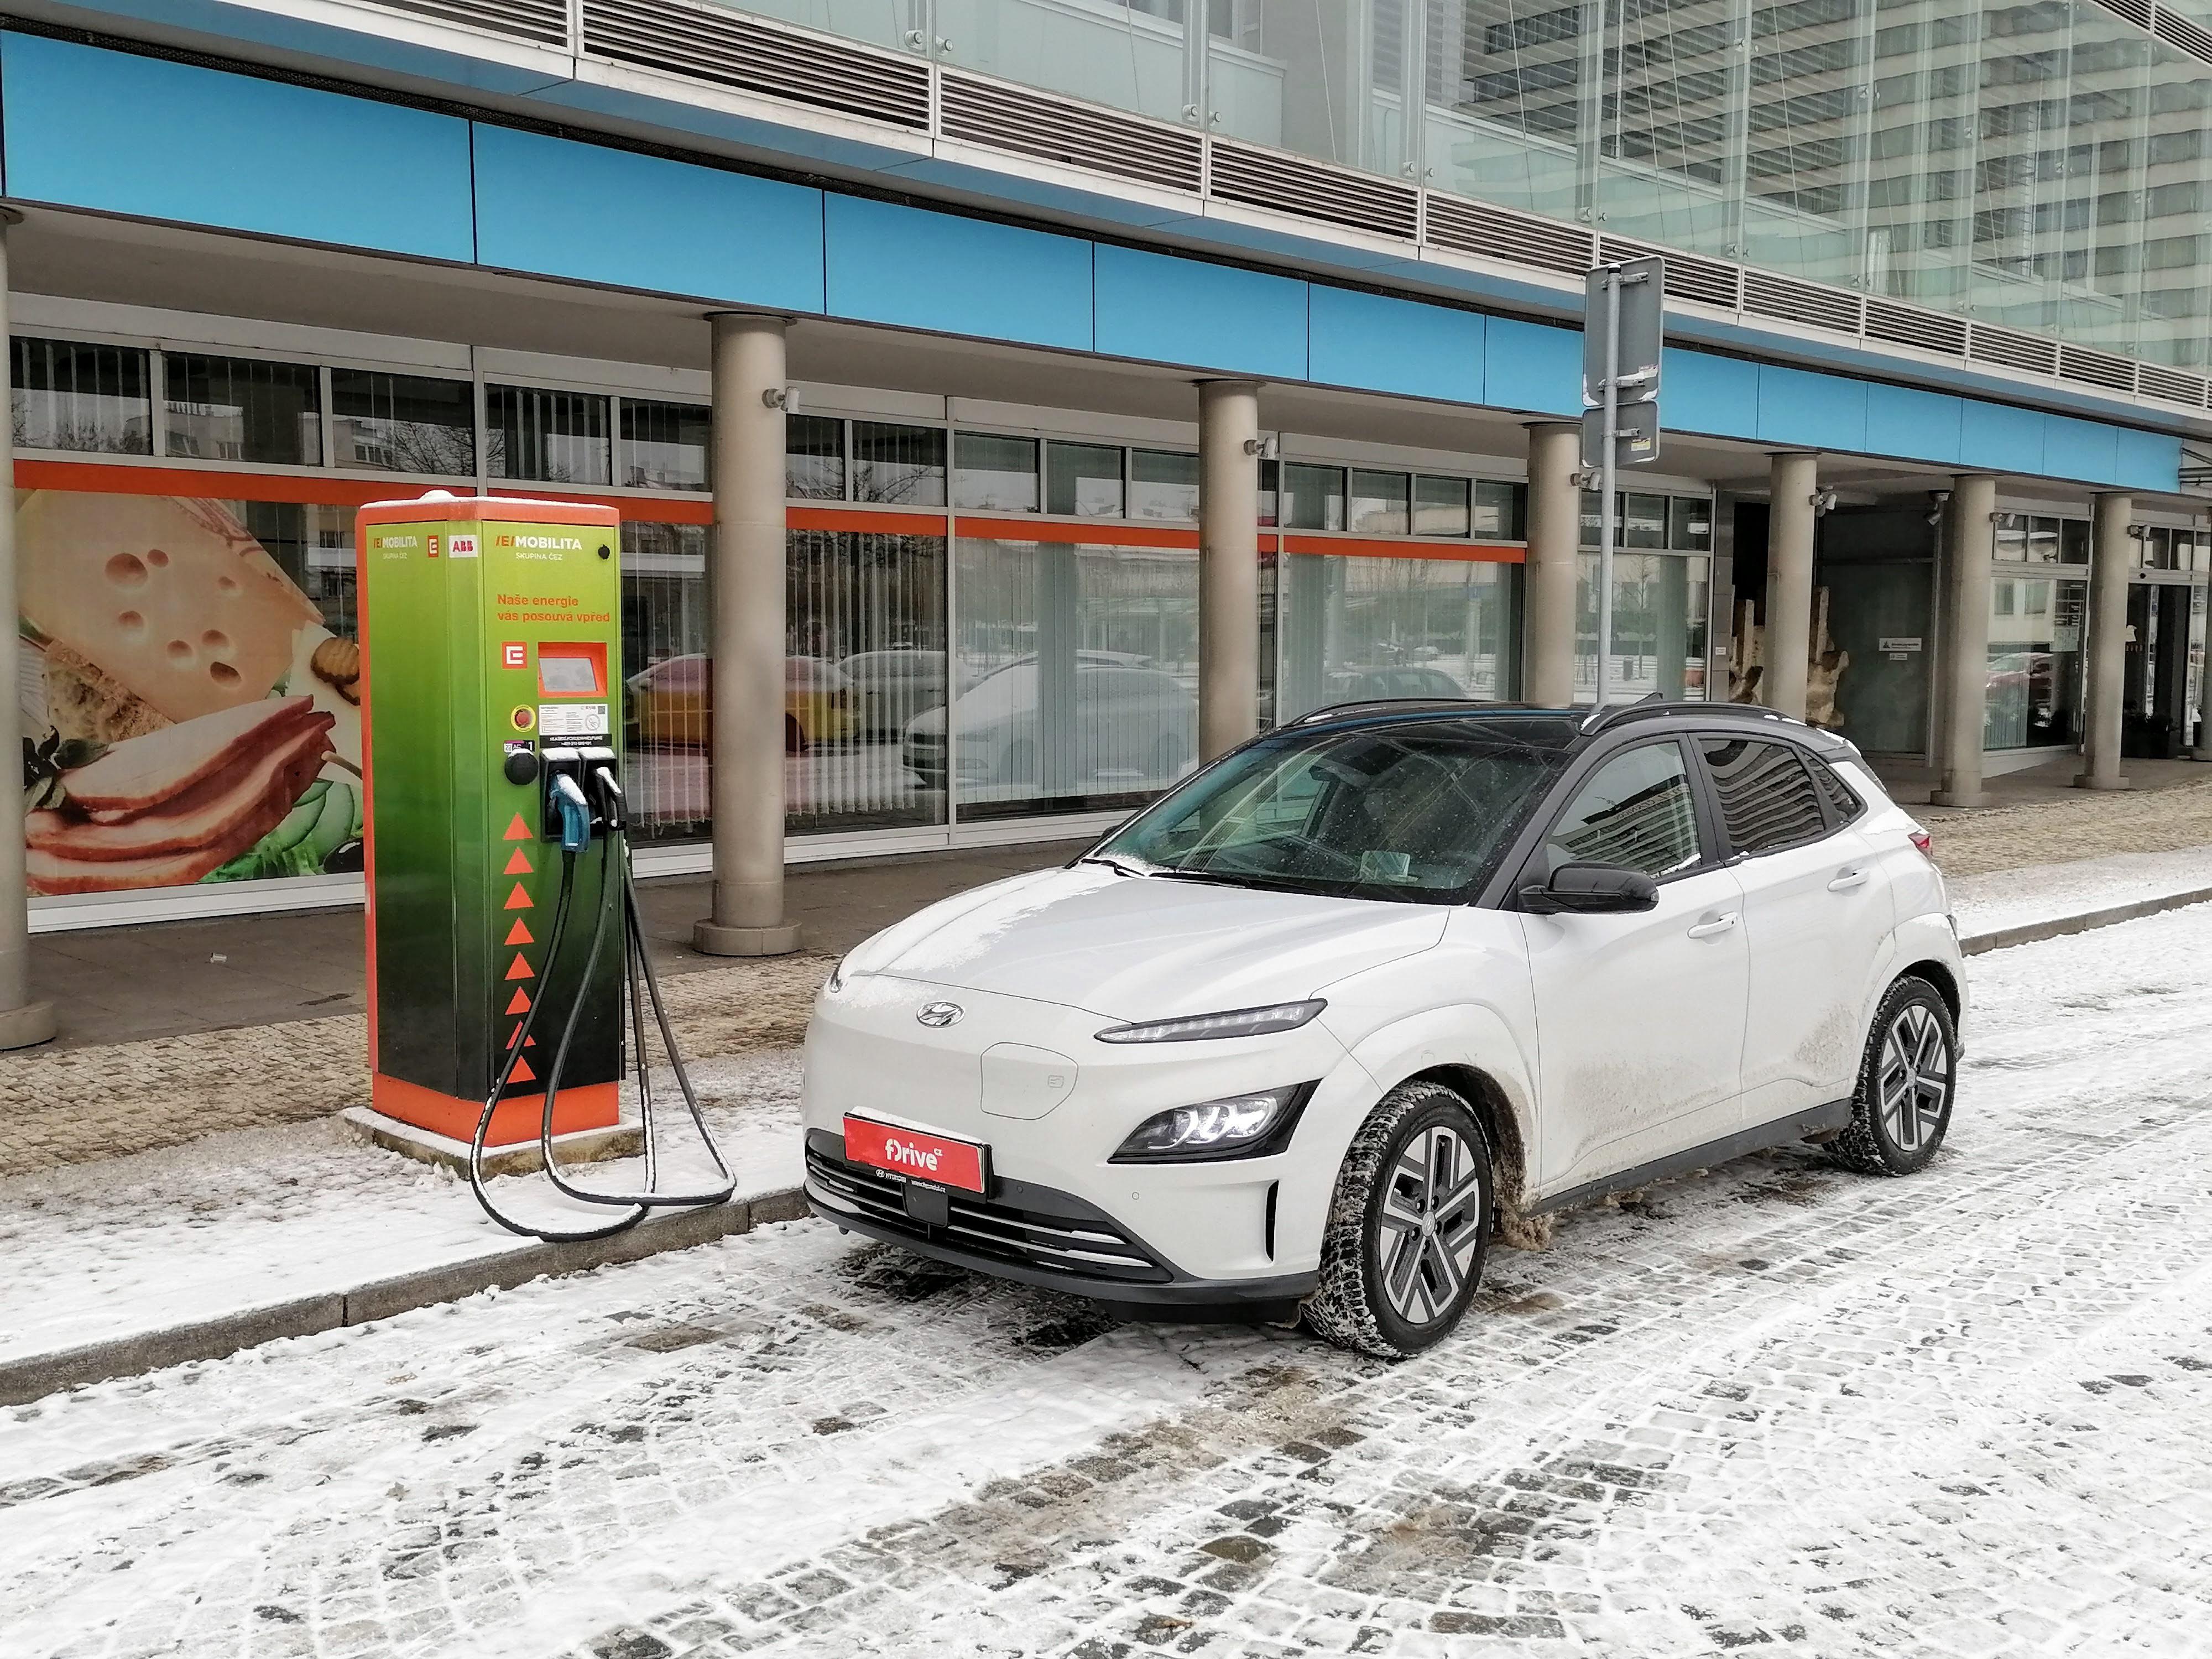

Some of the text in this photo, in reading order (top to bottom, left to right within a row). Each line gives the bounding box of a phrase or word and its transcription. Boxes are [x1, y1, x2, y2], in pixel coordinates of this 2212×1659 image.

[452, 540, 473, 552] ABB
[498, 594, 578, 608] Naše energie
[498, 610, 610, 623] vás posouvá vpřed
[885, 1138, 938, 1171] fDrive
